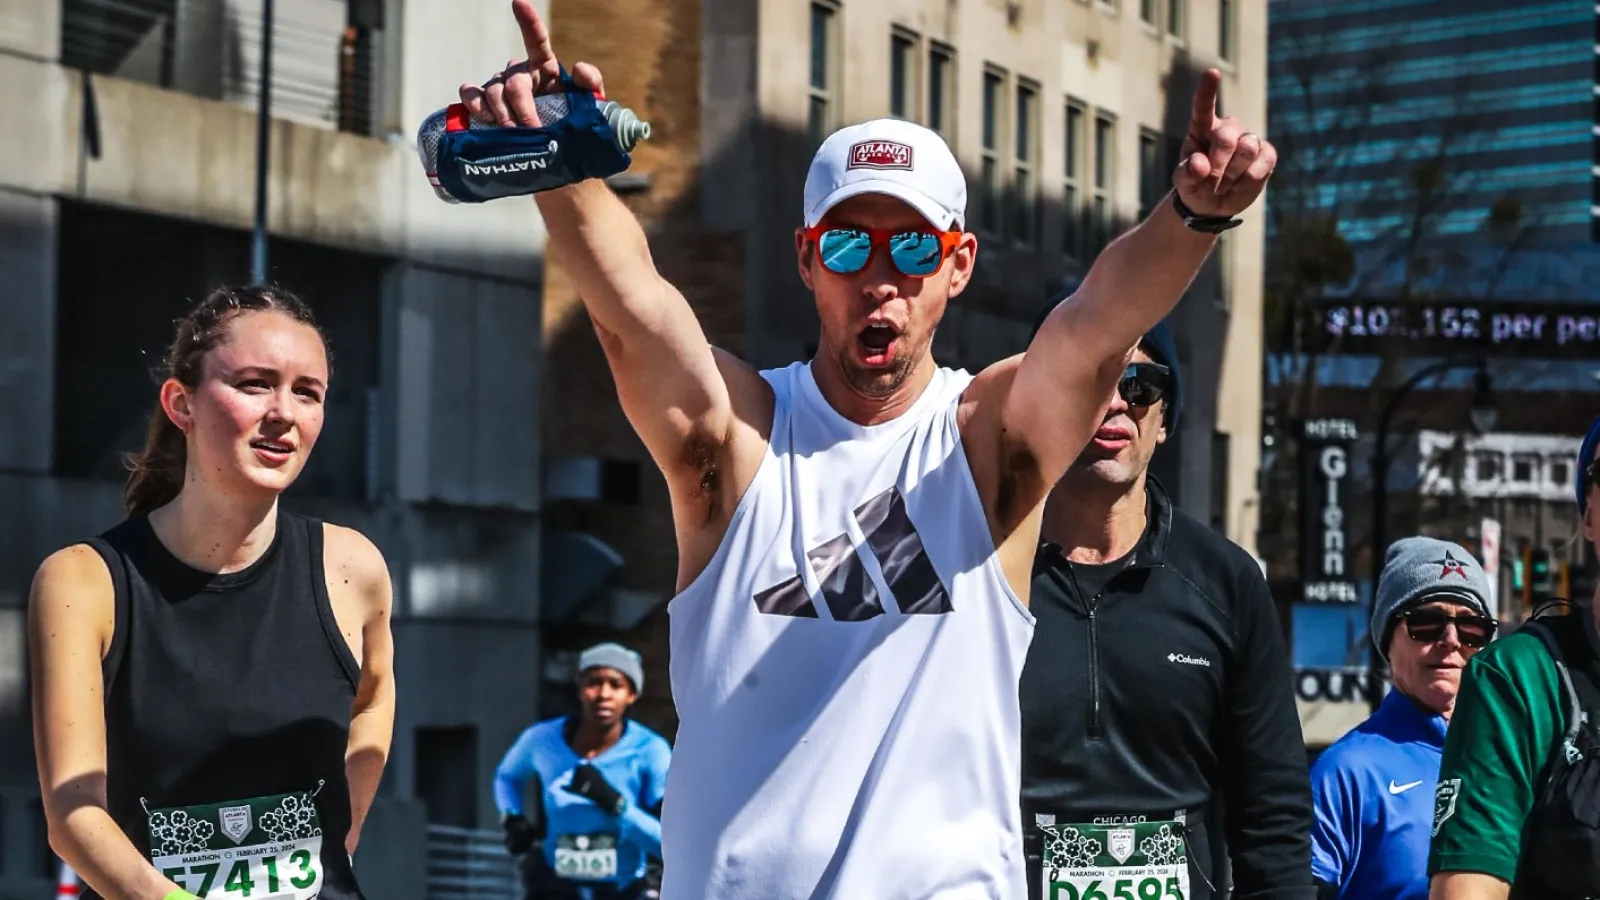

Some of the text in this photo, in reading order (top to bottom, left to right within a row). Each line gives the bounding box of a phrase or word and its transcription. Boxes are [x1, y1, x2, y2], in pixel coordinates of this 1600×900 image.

[857, 143, 907, 156] ATLANTA
[464, 157, 547, 175] NATHAN
[1326, 305, 1600, 344] $10,152 per pe
[1304, 418, 1359, 439] HOTEL
[1319, 446, 1347, 576] Glenn
[1304, 582, 1358, 602] HOTEL
[1176, 653, 1210, 667] Columbia
[1093, 815, 1147, 825] CHICAGO
[182, 853, 221, 864] MARATHON
[236, 847, 267, 857] FEBRUARY
